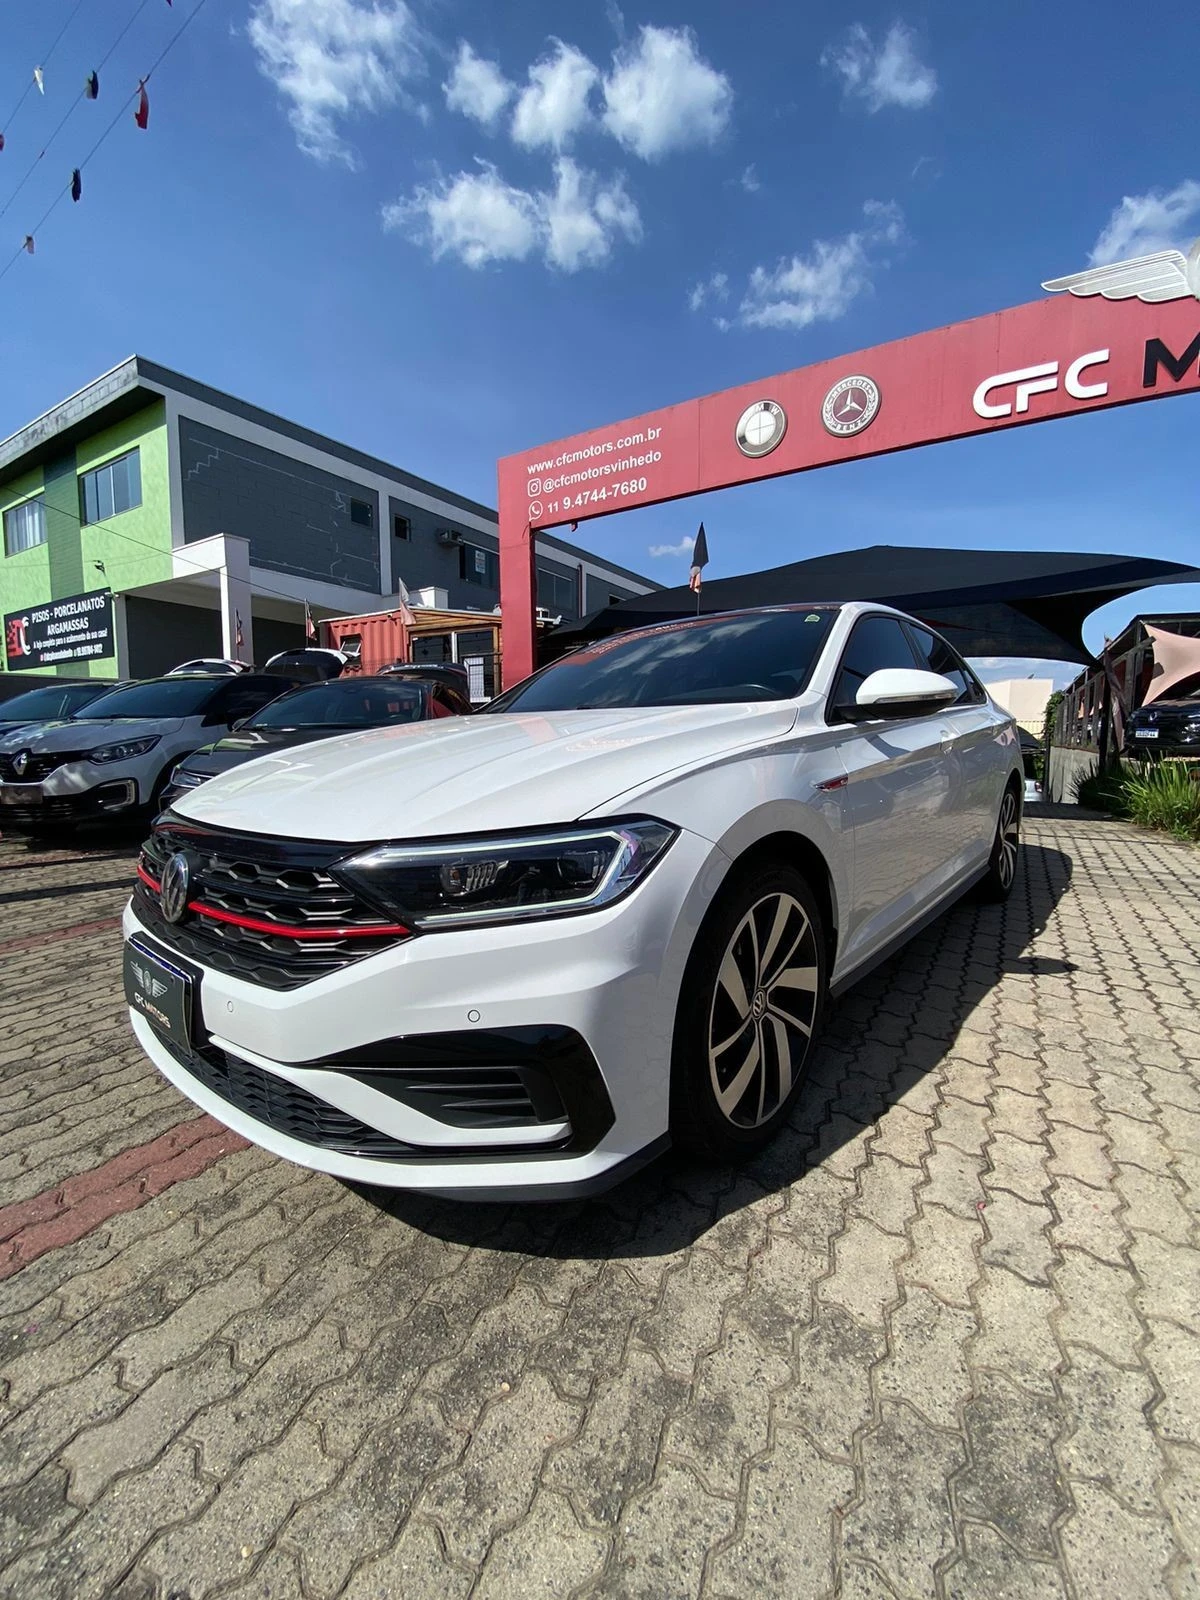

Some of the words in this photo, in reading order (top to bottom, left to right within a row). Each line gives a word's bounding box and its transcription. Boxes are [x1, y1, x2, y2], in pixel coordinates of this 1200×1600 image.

[831, 379, 872, 398] MERCEDES
[973, 349, 1110, 418] CFC
[836, 420, 862, 432] BENZ
[528, 427, 662, 474] www.cfcmotors.com.br
[543, 450, 662, 493] @cfcmotorsvinhedo
[547, 502, 558, 514] 11
[563, 477, 647, 510] 9.4744-7680
[31, 609, 50, 624] PISOS
[54, 595, 105, 618] PORCELANATOS
[47, 617, 89, 636] ARGAMASSAS
